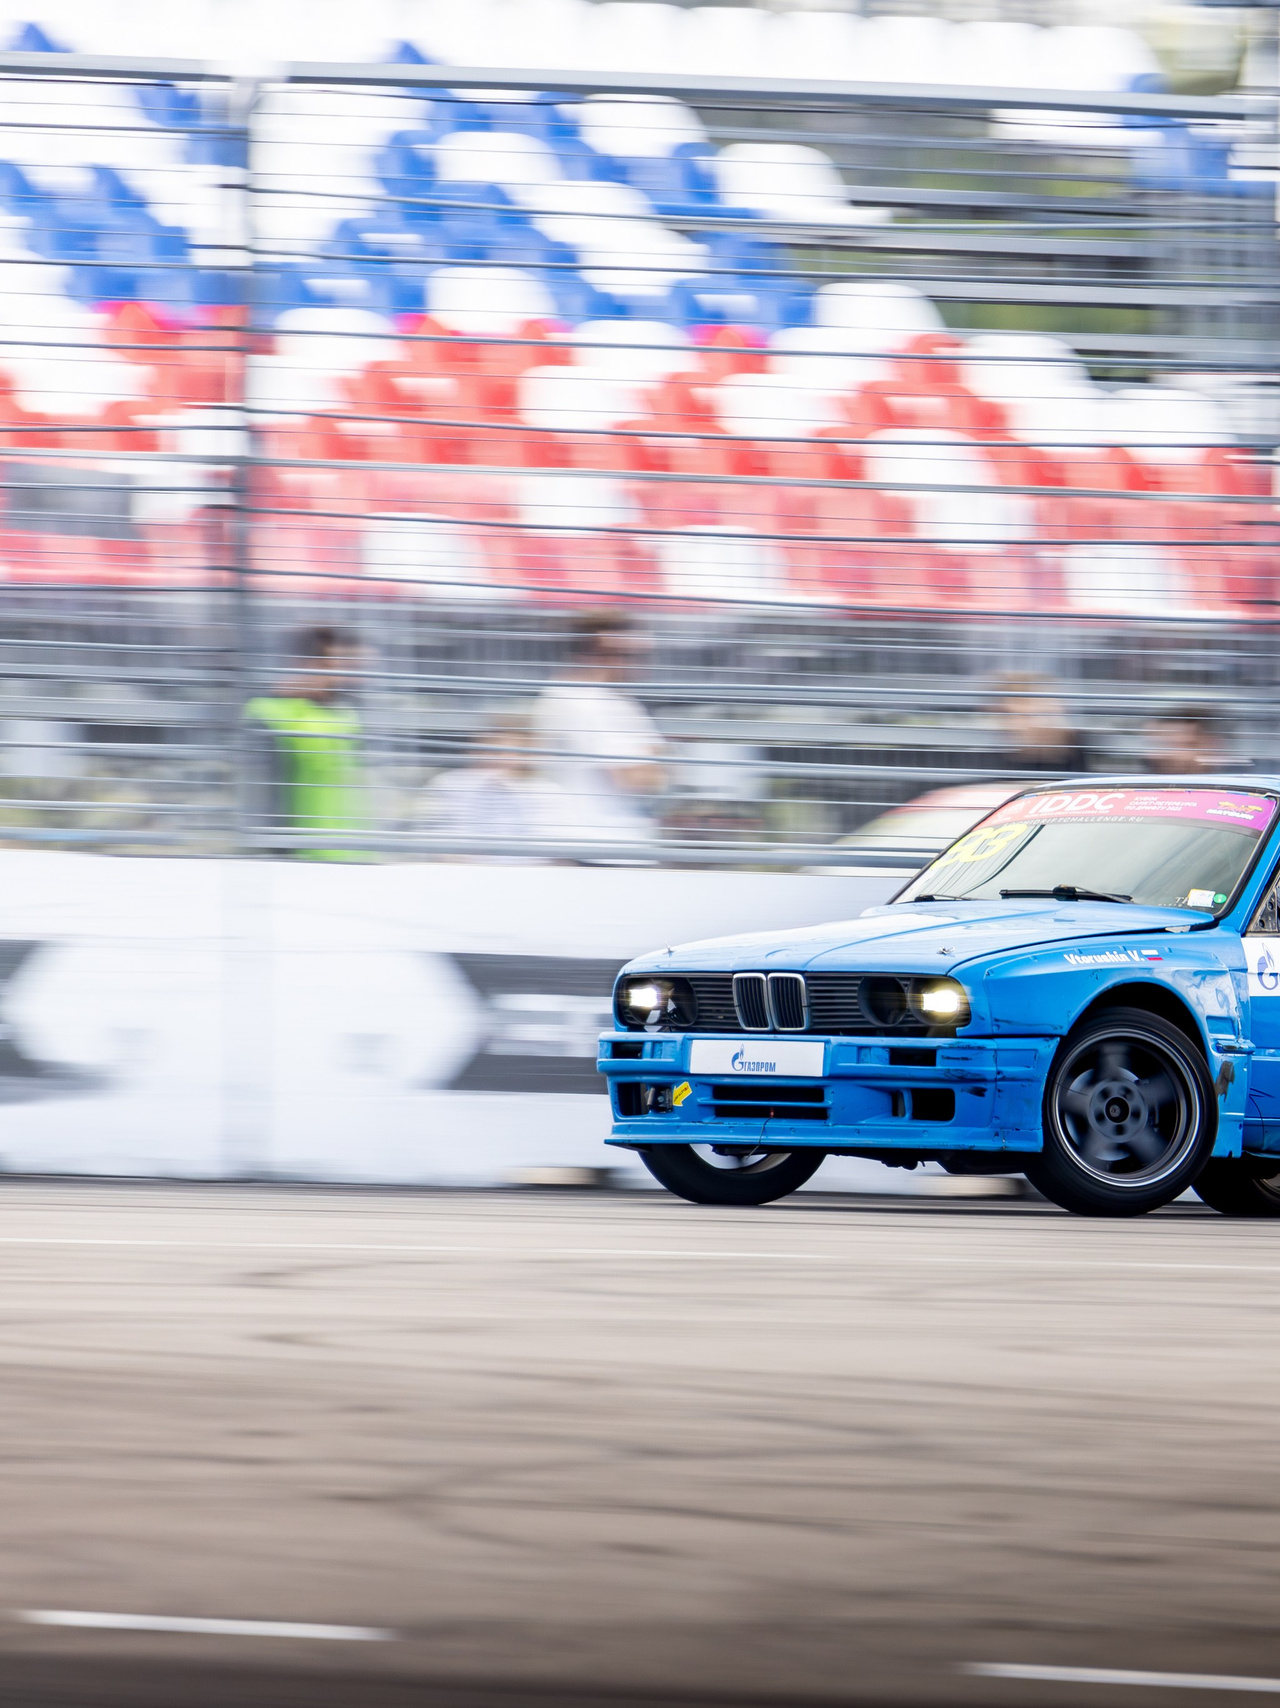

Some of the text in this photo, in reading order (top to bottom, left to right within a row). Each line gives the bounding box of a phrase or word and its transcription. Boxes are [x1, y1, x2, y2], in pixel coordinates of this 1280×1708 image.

[1028, 793, 1126, 814] IDDC
[1002, 815, 1144, 828] HIDRIFTCHALLENGE.RU
[1063, 950, 1146, 965] Vtorushin V.
[743, 1061, 776, 1073] ГАЗПРОМ
